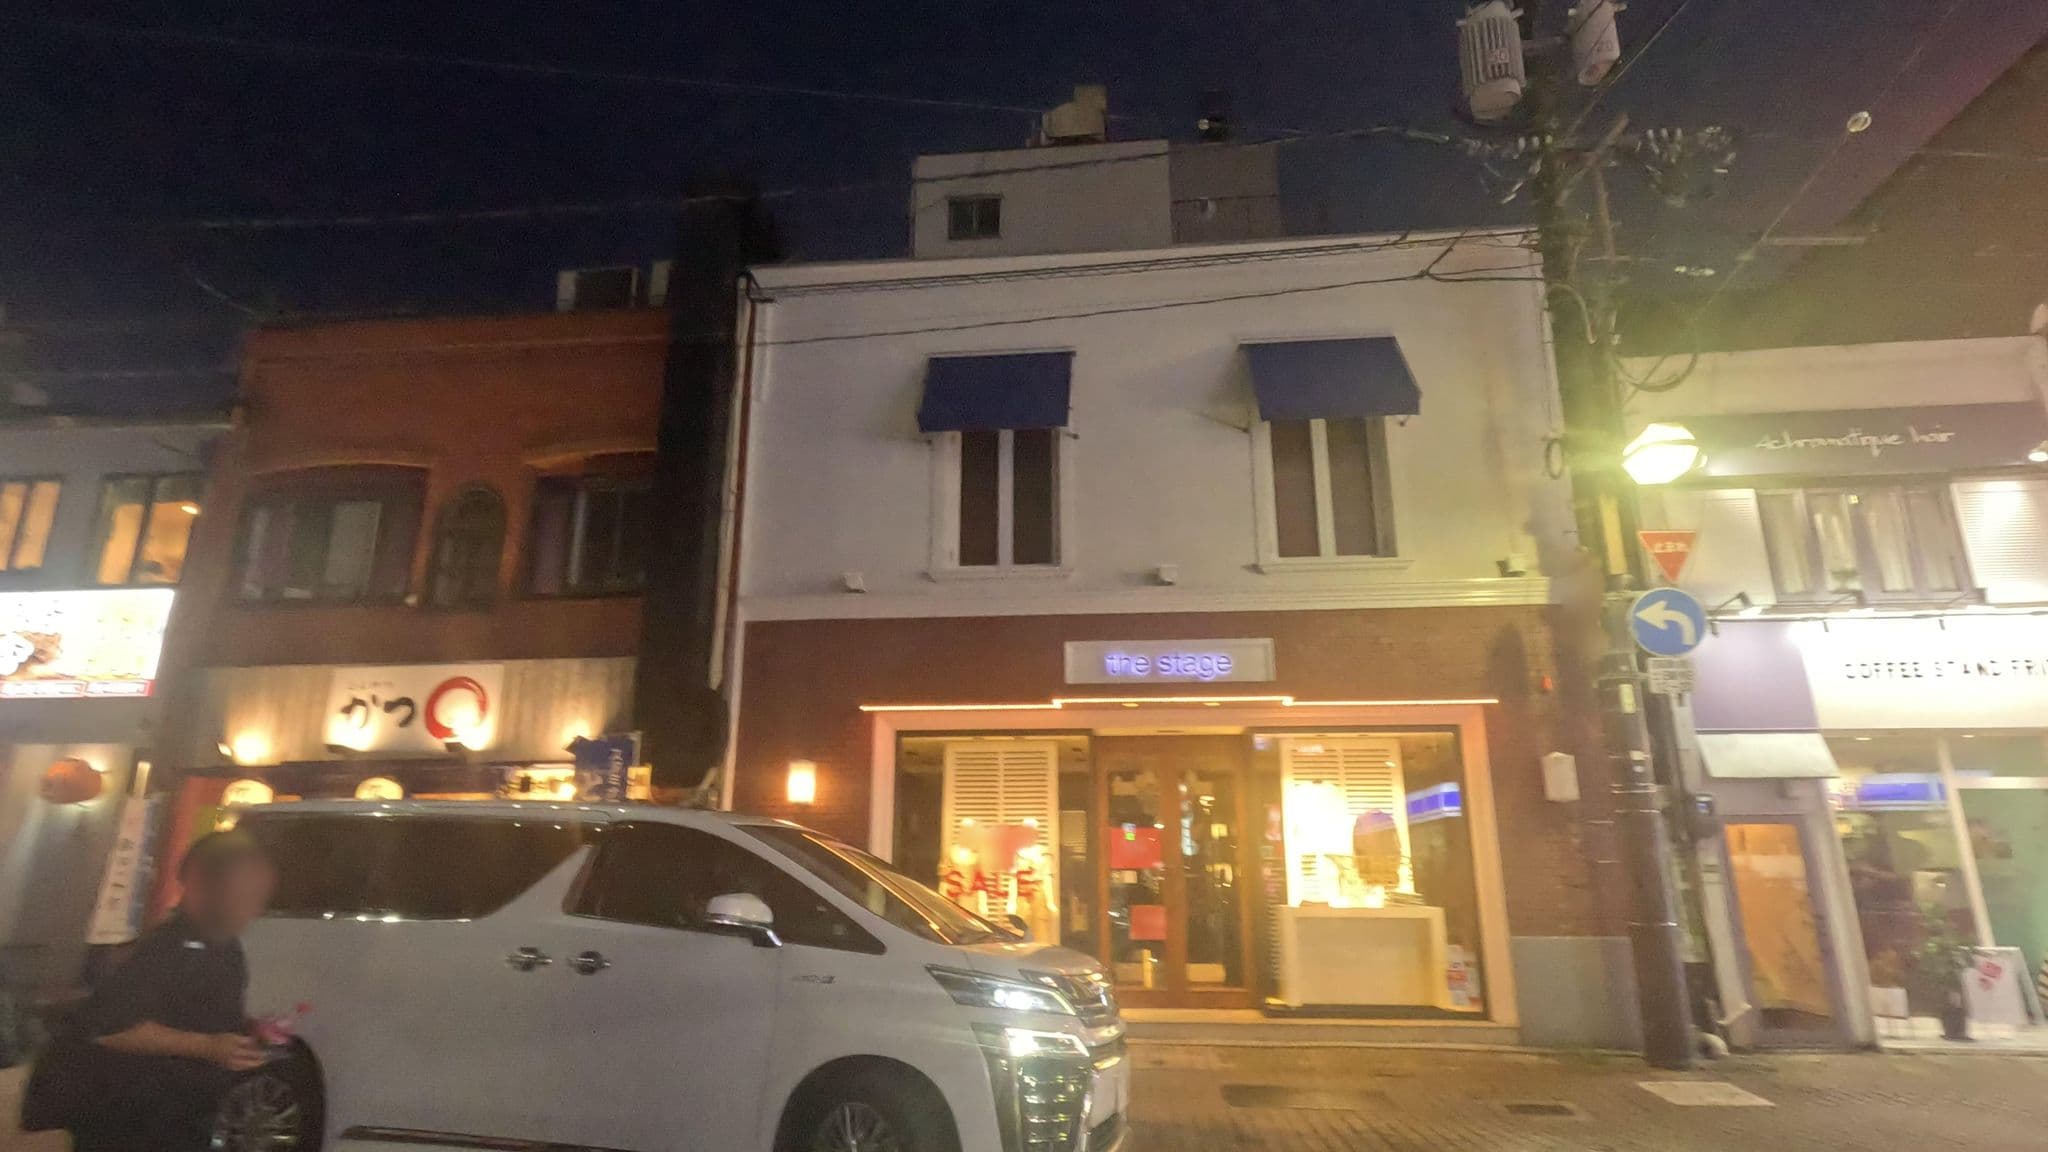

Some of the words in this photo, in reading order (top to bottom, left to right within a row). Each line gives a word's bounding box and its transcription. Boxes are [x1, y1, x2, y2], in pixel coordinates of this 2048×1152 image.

[1105, 653, 1150, 674] the
[1158, 653, 1233, 679] stage
[1845, 661, 1924, 678] COFFEE
[1934, 660, 2001, 677] STAND
